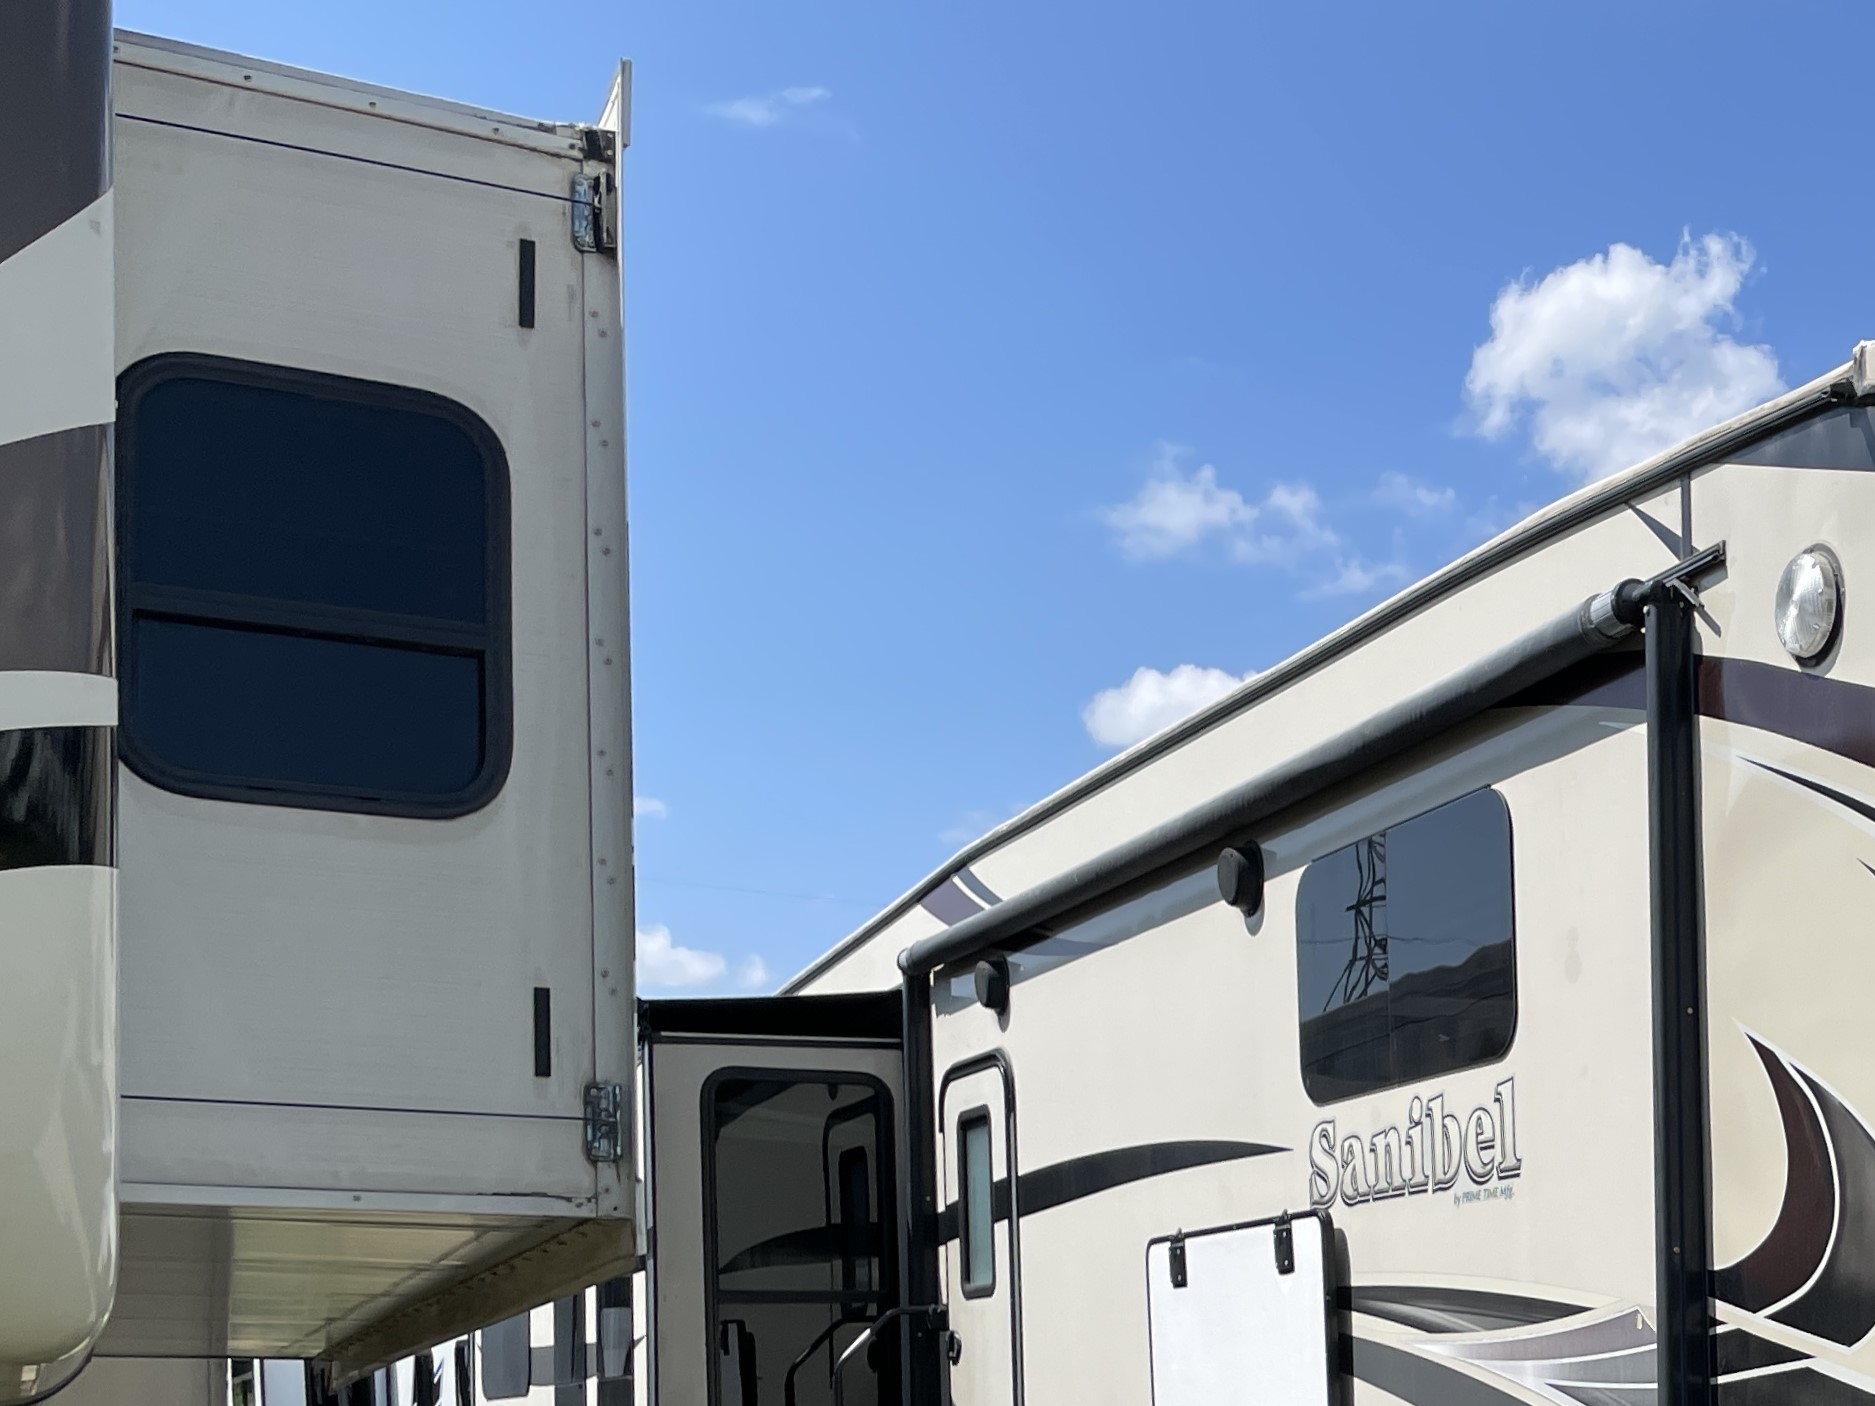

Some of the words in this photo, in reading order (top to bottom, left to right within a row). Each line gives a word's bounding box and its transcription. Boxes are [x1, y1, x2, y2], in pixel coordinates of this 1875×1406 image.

[1309, 1075, 1523, 1209] Sanibel
[1453, 1193, 1461, 1209] by
[1462, 1189, 1482, 1205] PRIME
[1483, 1186, 1499, 1201] TIME
